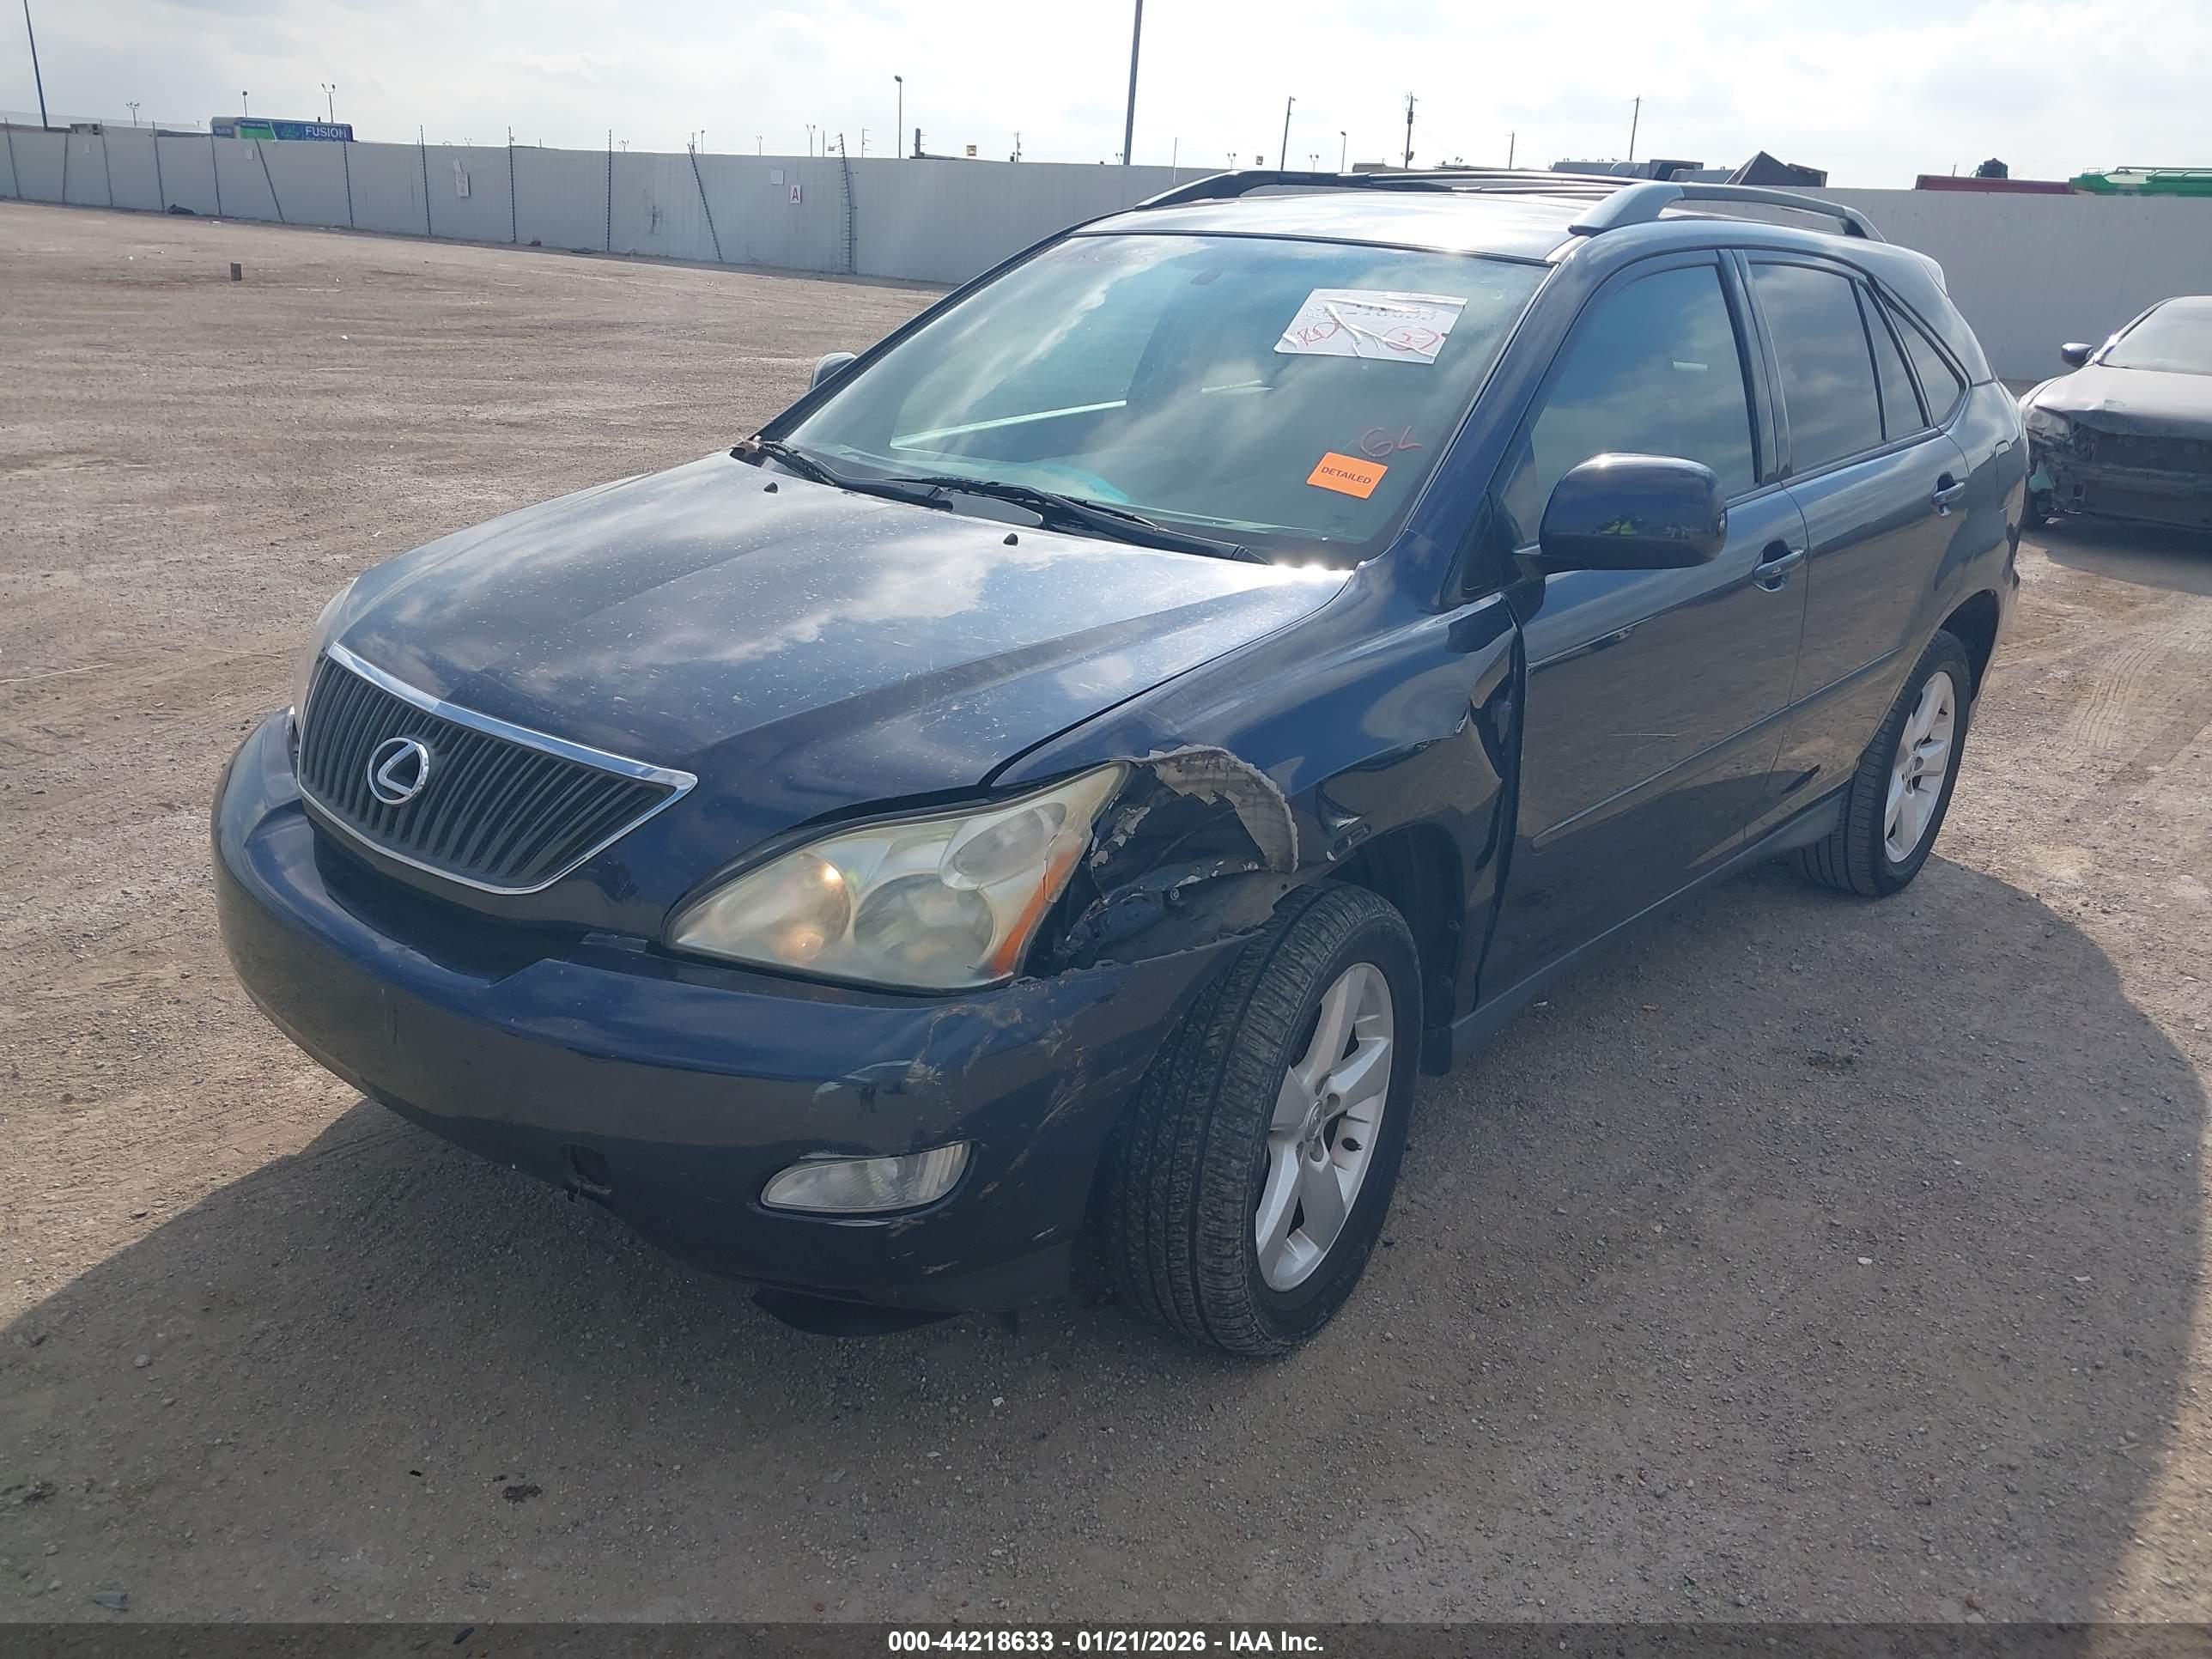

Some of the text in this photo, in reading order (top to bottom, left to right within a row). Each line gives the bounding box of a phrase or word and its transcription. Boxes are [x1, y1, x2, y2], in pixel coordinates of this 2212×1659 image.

[306, 125, 347, 138] FUSION
[792, 186, 799, 202] A
[1321, 465, 1372, 485] DETAILED
